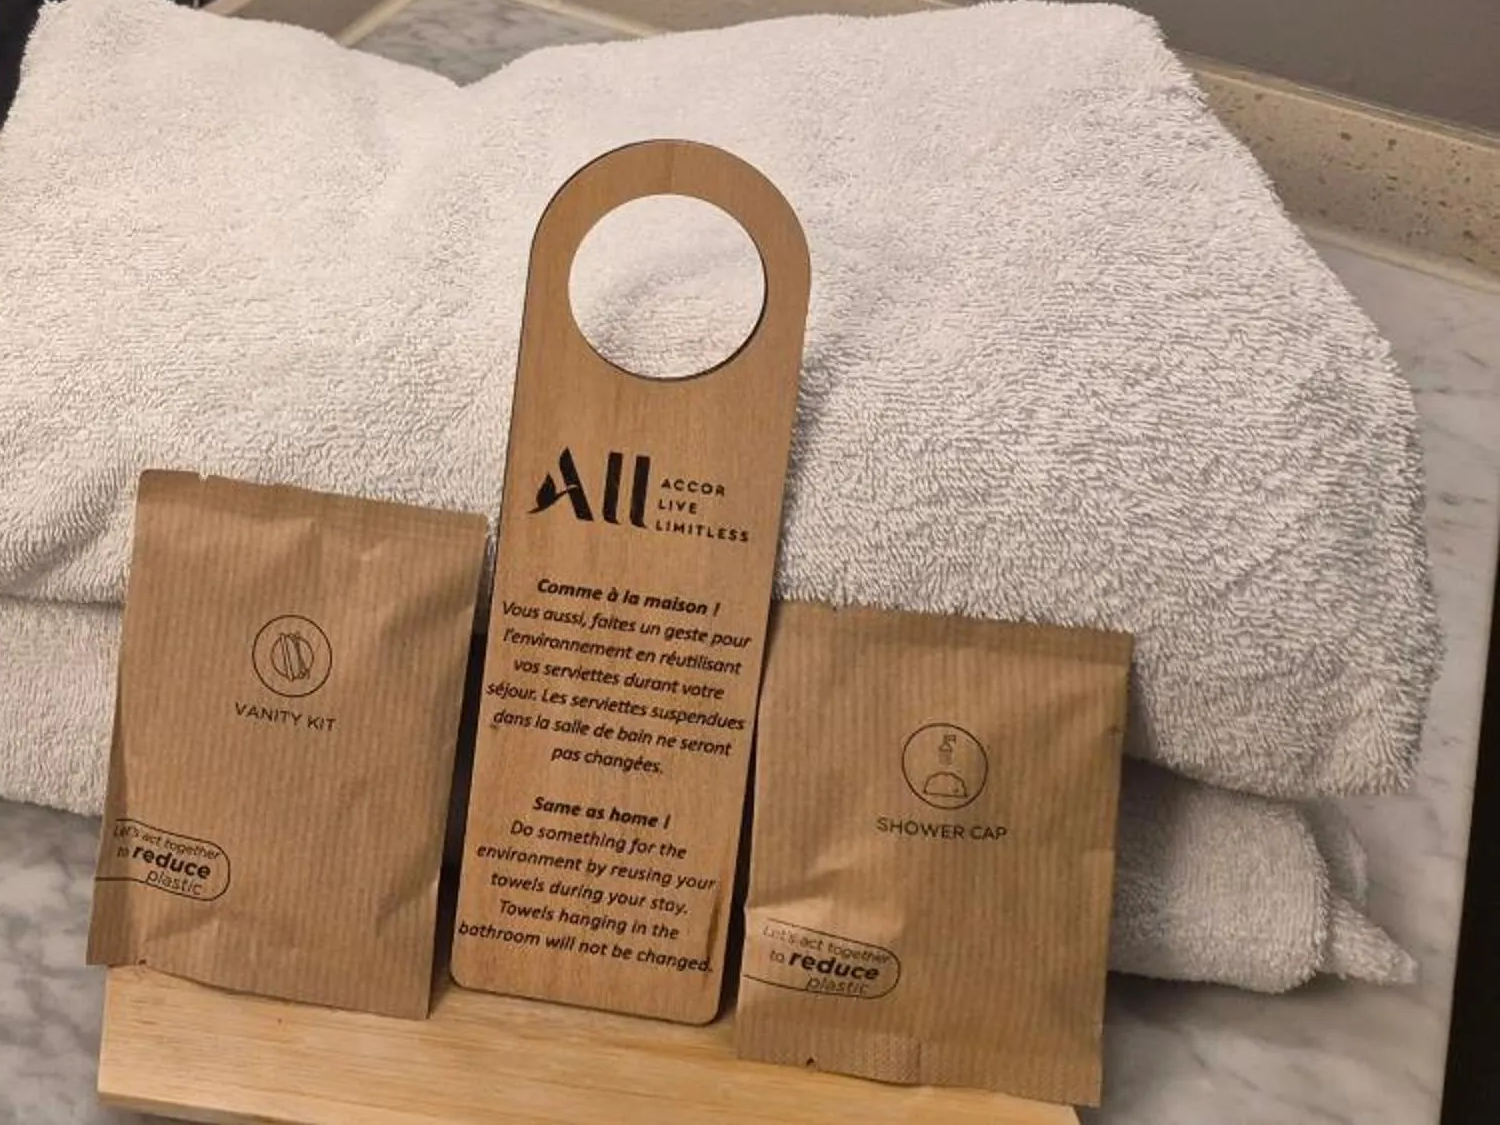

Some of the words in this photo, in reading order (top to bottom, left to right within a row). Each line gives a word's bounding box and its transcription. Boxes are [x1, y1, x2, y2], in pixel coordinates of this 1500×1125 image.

[661, 478, 726, 497] ACCOR
[658, 500, 698, 514] LIVE
[655, 520, 749, 542] LIMITLESS
[537, 578, 603, 600] Comme
[607, 586, 619, 602] à
[622, 590, 640, 605] la
[643, 596, 708, 615] maison
[712, 602, 721, 617] !
[502, 600, 539, 619] Vous
[543, 610, 587, 627] aussi,
[589, 612, 636, 632] faites
[640, 623, 661, 636] un
[664, 626, 708, 643] geste
[710, 632, 752, 648] pour
[636, 650, 656, 663] en
[659, 651, 742, 675] réutilisant
[514, 658, 541, 674] vos
[544, 664, 619, 686] serviettes
[624, 672, 679, 694] durant
[682, 684, 724, 700] votre
[235, 702, 302, 725] VANITY
[307, 715, 337, 731] KIT
[486, 680, 537, 701] séjour.
[541, 689, 567, 704] Les
[570, 694, 646, 716] serviettes
[651, 706, 746, 730] suspendues
[493, 709, 532, 727] dans
[535, 715, 550, 729] la
[552, 719, 590, 736] salle
[593, 723, 614, 740] de
[617, 726, 653, 746] bain
[656, 734, 677, 748] ne
[680, 737, 732, 756] seront
[551, 747, 581, 762] pas
[584, 749, 663, 774] changées.
[532, 796, 582, 817] Same
[585, 806, 605, 820] as
[609, 806, 658, 828] home
[510, 819, 534, 837] Do
[537, 826, 626, 854] something
[628, 837, 657, 855] for
[659, 842, 687, 860] the
[876, 817, 964, 840] SHOWER
[969, 826, 1008, 841] CAP
[132, 846, 211, 879] reduce
[164, 838, 220, 860] together
[145, 870, 202, 895] plastic
[477, 844, 583, 871] environment
[585, 858, 607, 877] by
[610, 864, 673, 887] reusing
[675, 874, 717, 890] your
[490, 872, 545, 892] towels
[549, 880, 604, 904] during
[607, 891, 646, 907] your
[649, 896, 688, 915] stay.
[499, 898, 555, 921] Towels
[558, 908, 627, 936] hanging
[631, 919, 647, 936] in
[651, 922, 680, 940] the
[458, 919, 541, 947] bathroom
[545, 935, 577, 952] will
[578, 941, 608, 956] not
[611, 943, 633, 960] be
[636, 947, 713, 972] changed.
[800, 935, 824, 951] act
[828, 942, 891, 964] together
[770, 950, 784, 963] to
[788, 951, 880, 980] reduce
[806, 976, 869, 995] plastic
